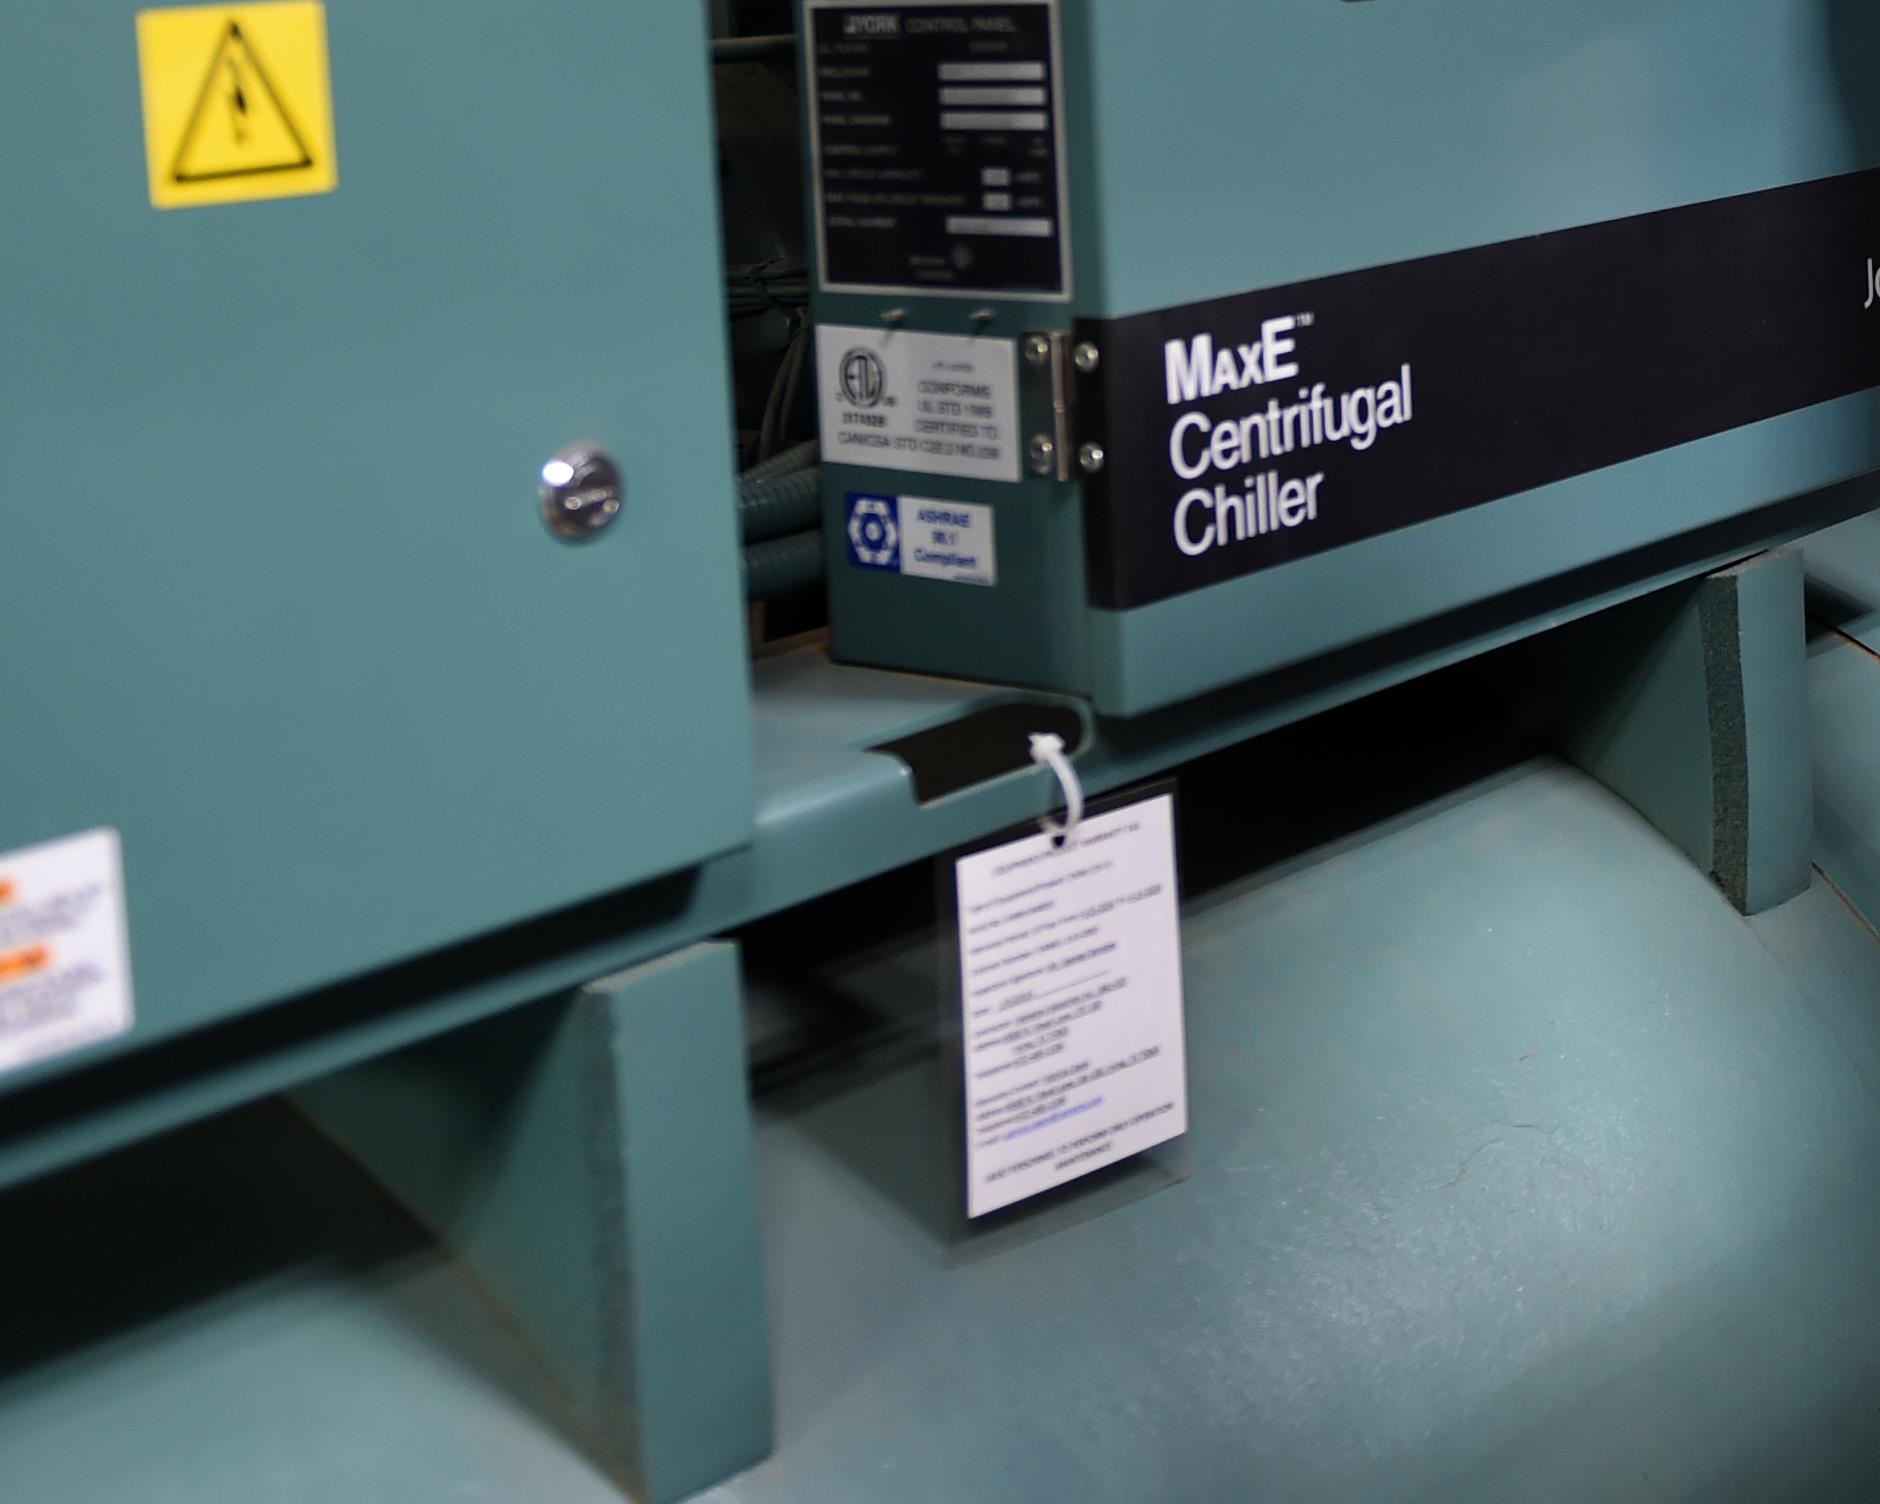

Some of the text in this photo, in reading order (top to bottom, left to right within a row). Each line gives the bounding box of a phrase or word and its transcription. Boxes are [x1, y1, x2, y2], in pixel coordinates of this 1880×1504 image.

[917, 380, 992, 397] CONFORMS
[915, 418, 979, 438] CERTIFIED
[1169, 362, 1413, 480] Centrifugal
[915, 508, 971, 528] ASHRAE
[1173, 470, 1325, 557] Chiller
[913, 548, 977, 568] Compliant
